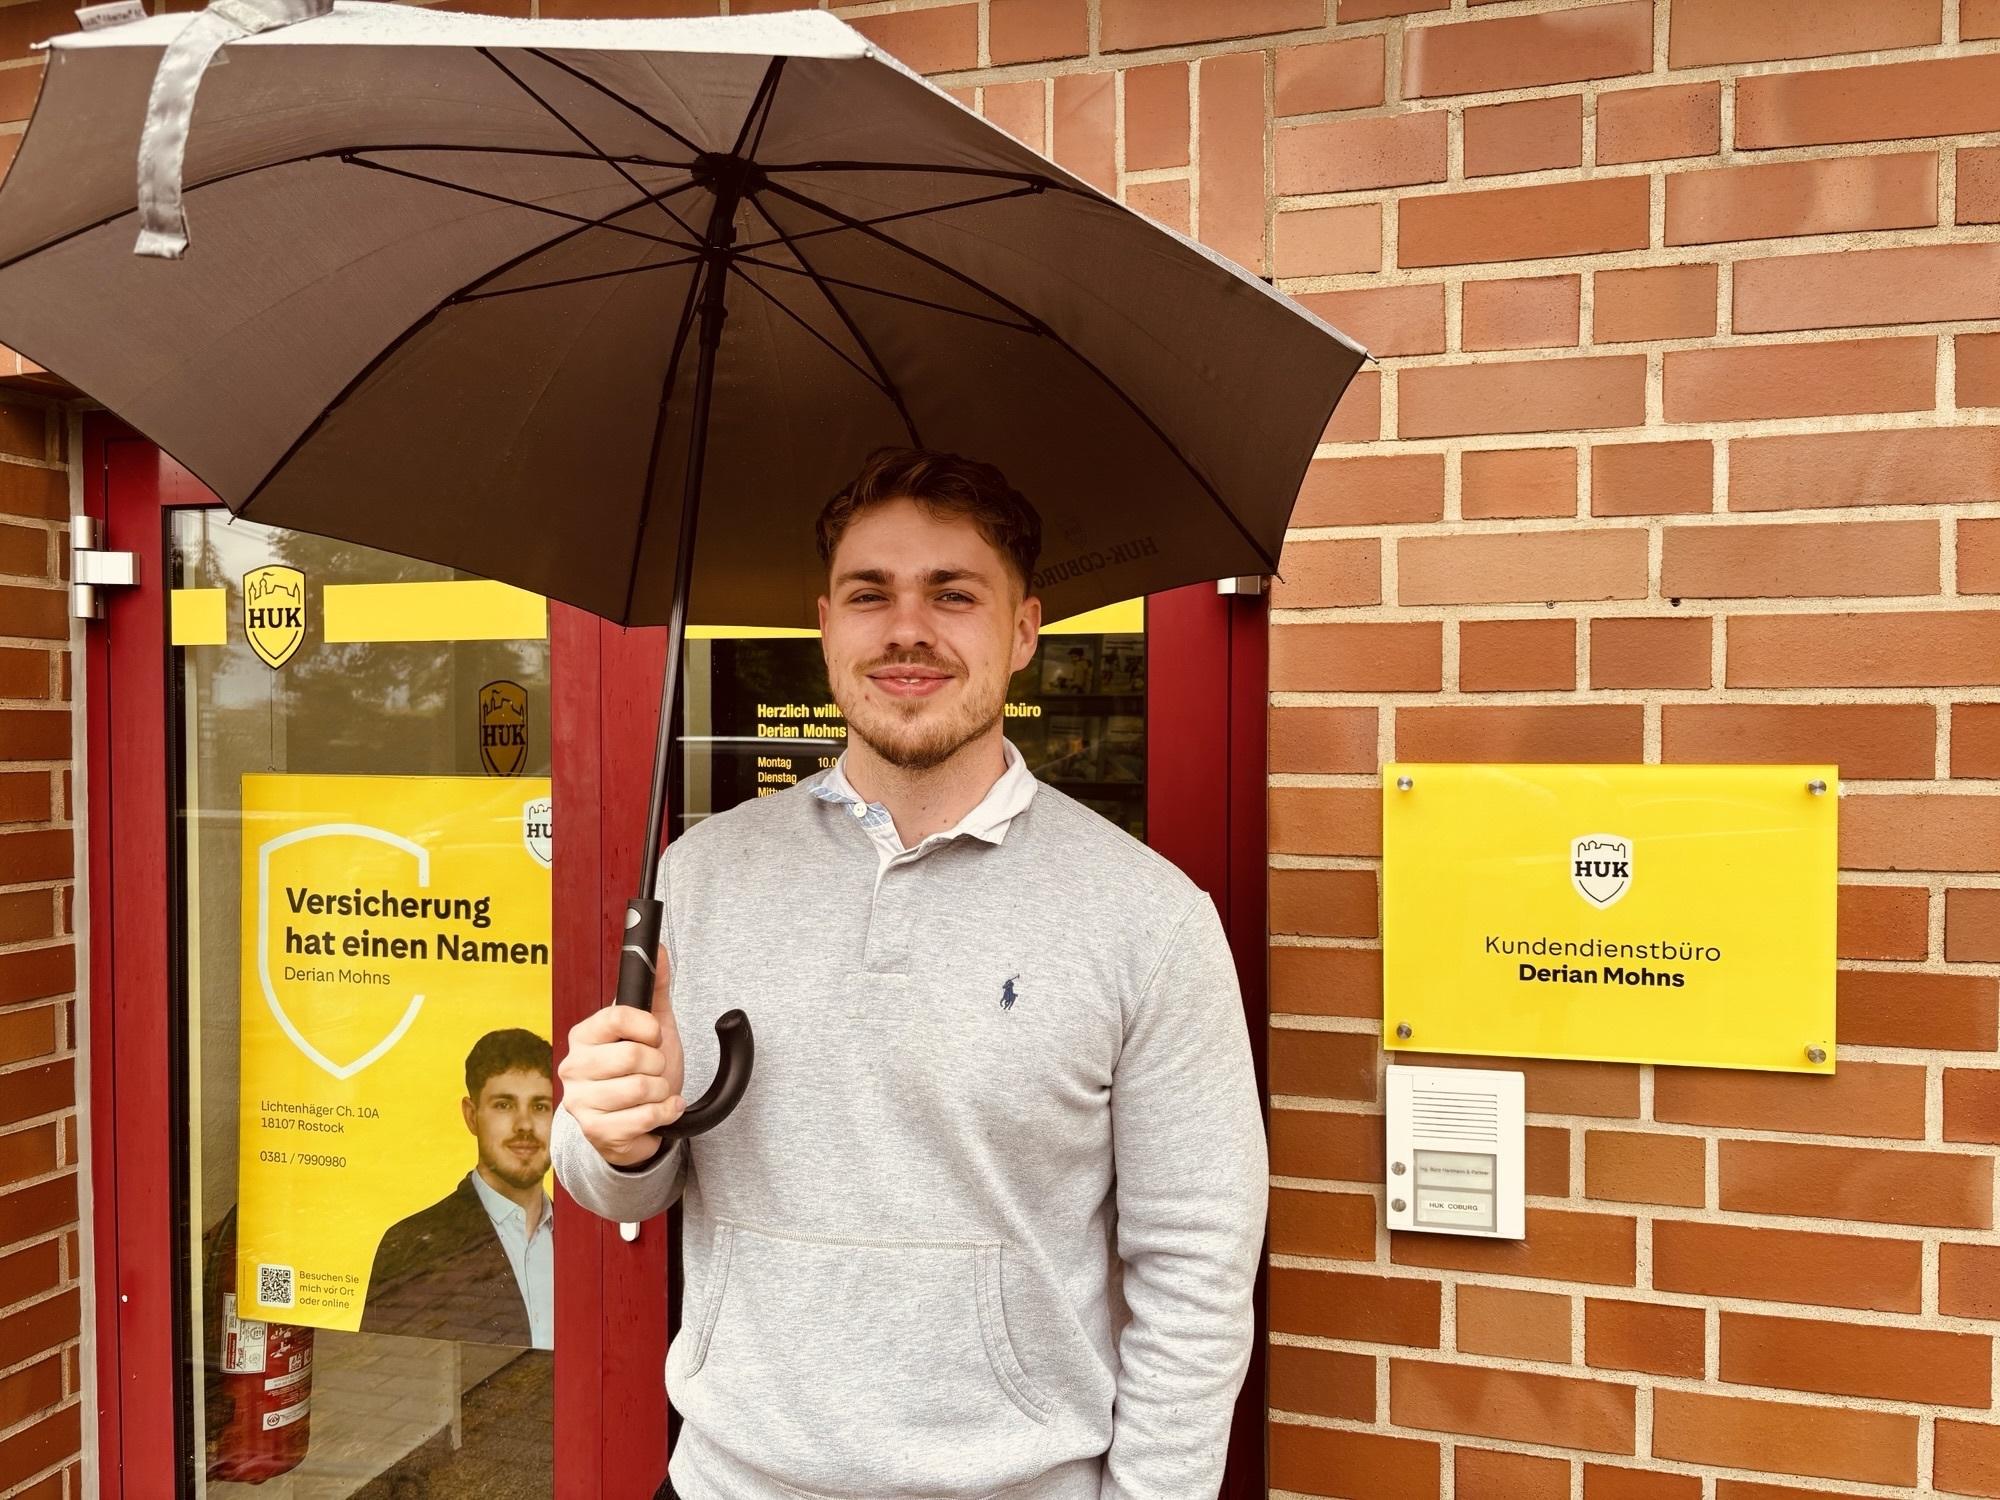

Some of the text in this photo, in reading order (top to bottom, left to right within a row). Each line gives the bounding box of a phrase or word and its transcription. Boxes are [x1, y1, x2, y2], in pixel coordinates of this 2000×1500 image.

[248, 607, 303, 629] HUK
[757, 703, 810, 718] Herzlich
[482, 724, 526, 747] HUK
[757, 723, 847, 738] Derian Mohns
[757, 756, 792, 770] Montag
[757, 771, 797, 785] Dienstag
[1574, 860, 1629, 878] HUK
[285, 887, 491, 928] Versicherung
[285, 926, 549, 965] hat einen Namen
[1485, 936, 1721, 962] Kundendienstbüro
[284, 966, 391, 985] Derian Mohns
[1519, 963, 1685, 988] Derian Mohns
[261, 1100, 380, 1119] Lichtenhäger Ch. 10A
[261, 1117, 345, 1133] 18107 Rostock
[260, 1150, 288, 1164] 0381
[298, 1153, 347, 1168] 7990980
[1448, 1203, 1478, 1211] COBURG
[300, 1271, 359, 1284] Besuchen Sie
[300, 1284, 322, 1293] mich
[340, 1287, 355, 1297] Ort
[300, 1296, 350, 1309] oder online
